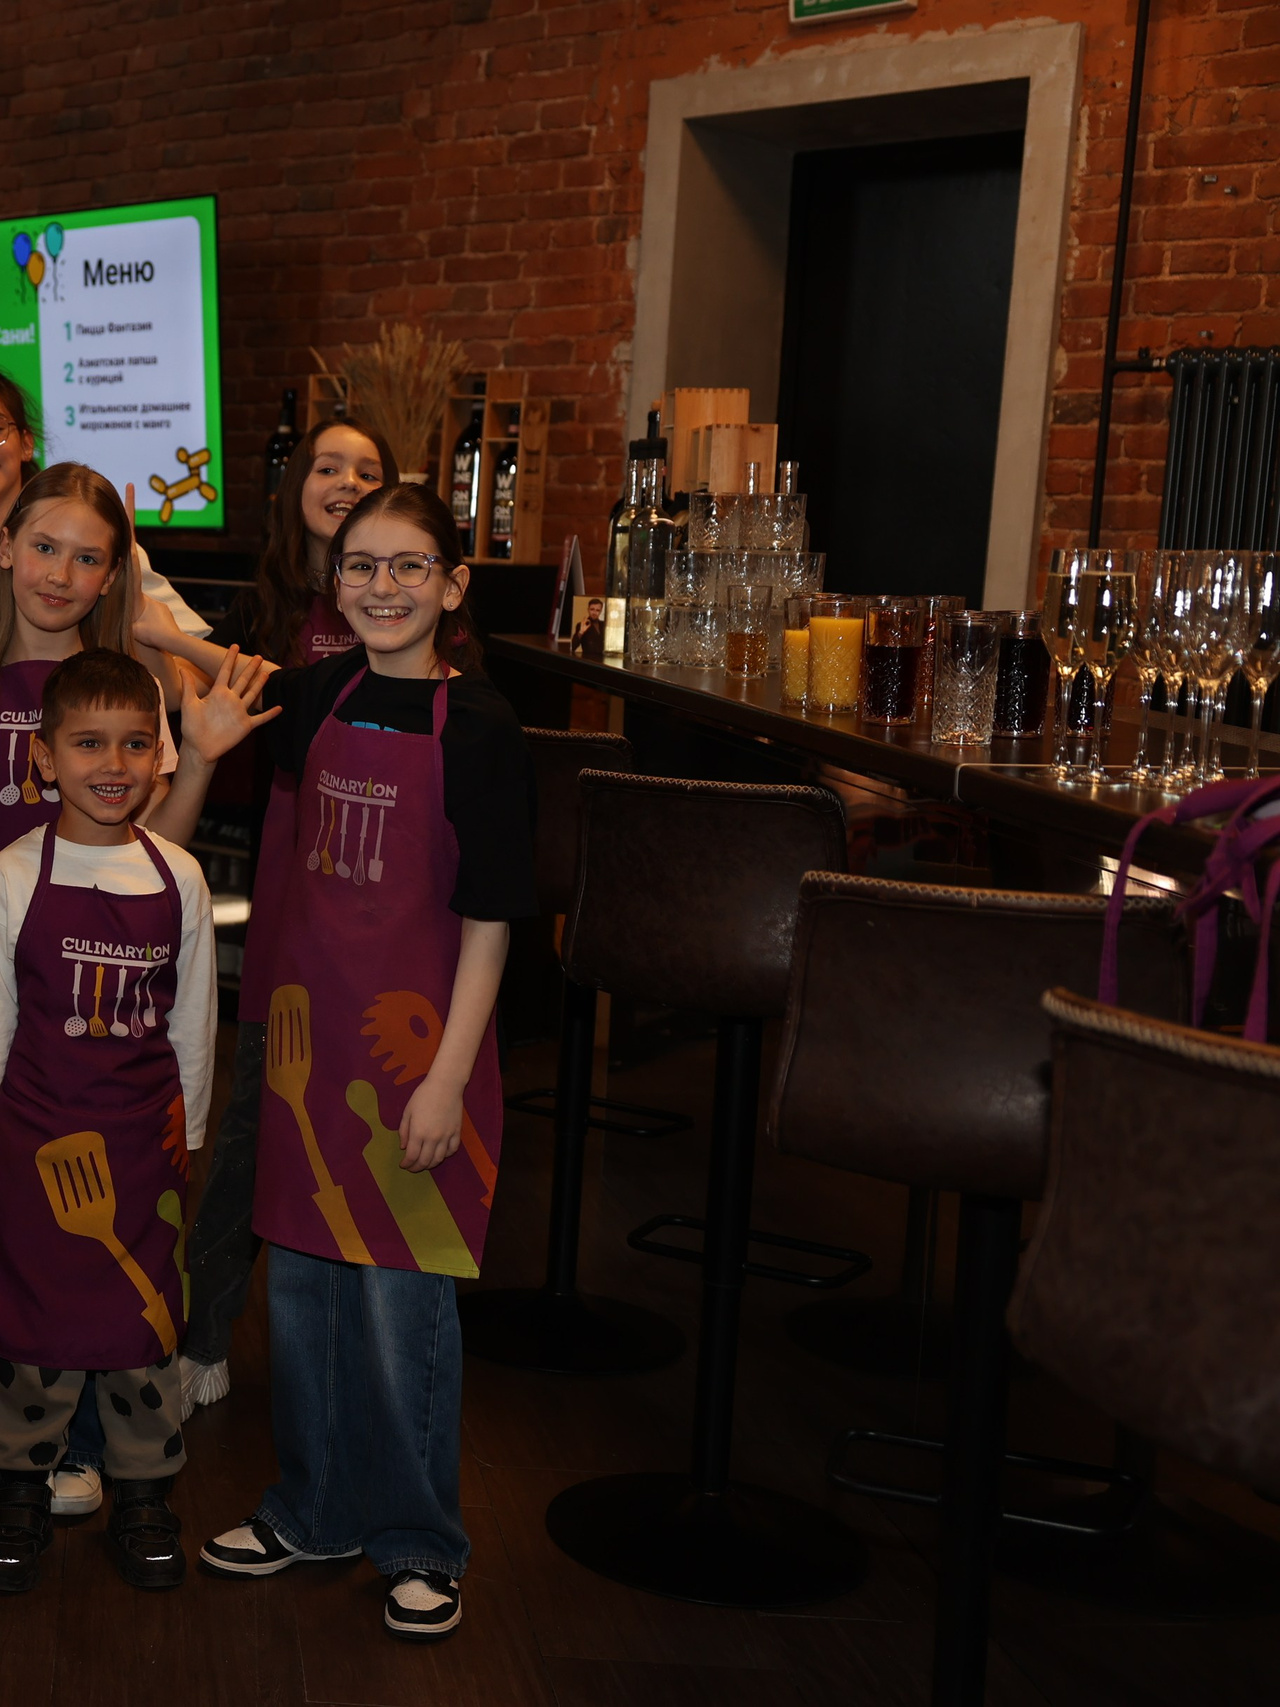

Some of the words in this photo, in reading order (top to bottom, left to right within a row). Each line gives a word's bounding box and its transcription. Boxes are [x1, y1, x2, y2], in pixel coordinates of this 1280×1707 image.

[83, 258, 154, 287] Меню
[63, 320, 72, 341] 1
[76, 323, 105, 335] Пицца
[107, 321, 153, 333] Фантазия
[63, 361, 74, 383] 2
[64, 405, 75, 426] 3
